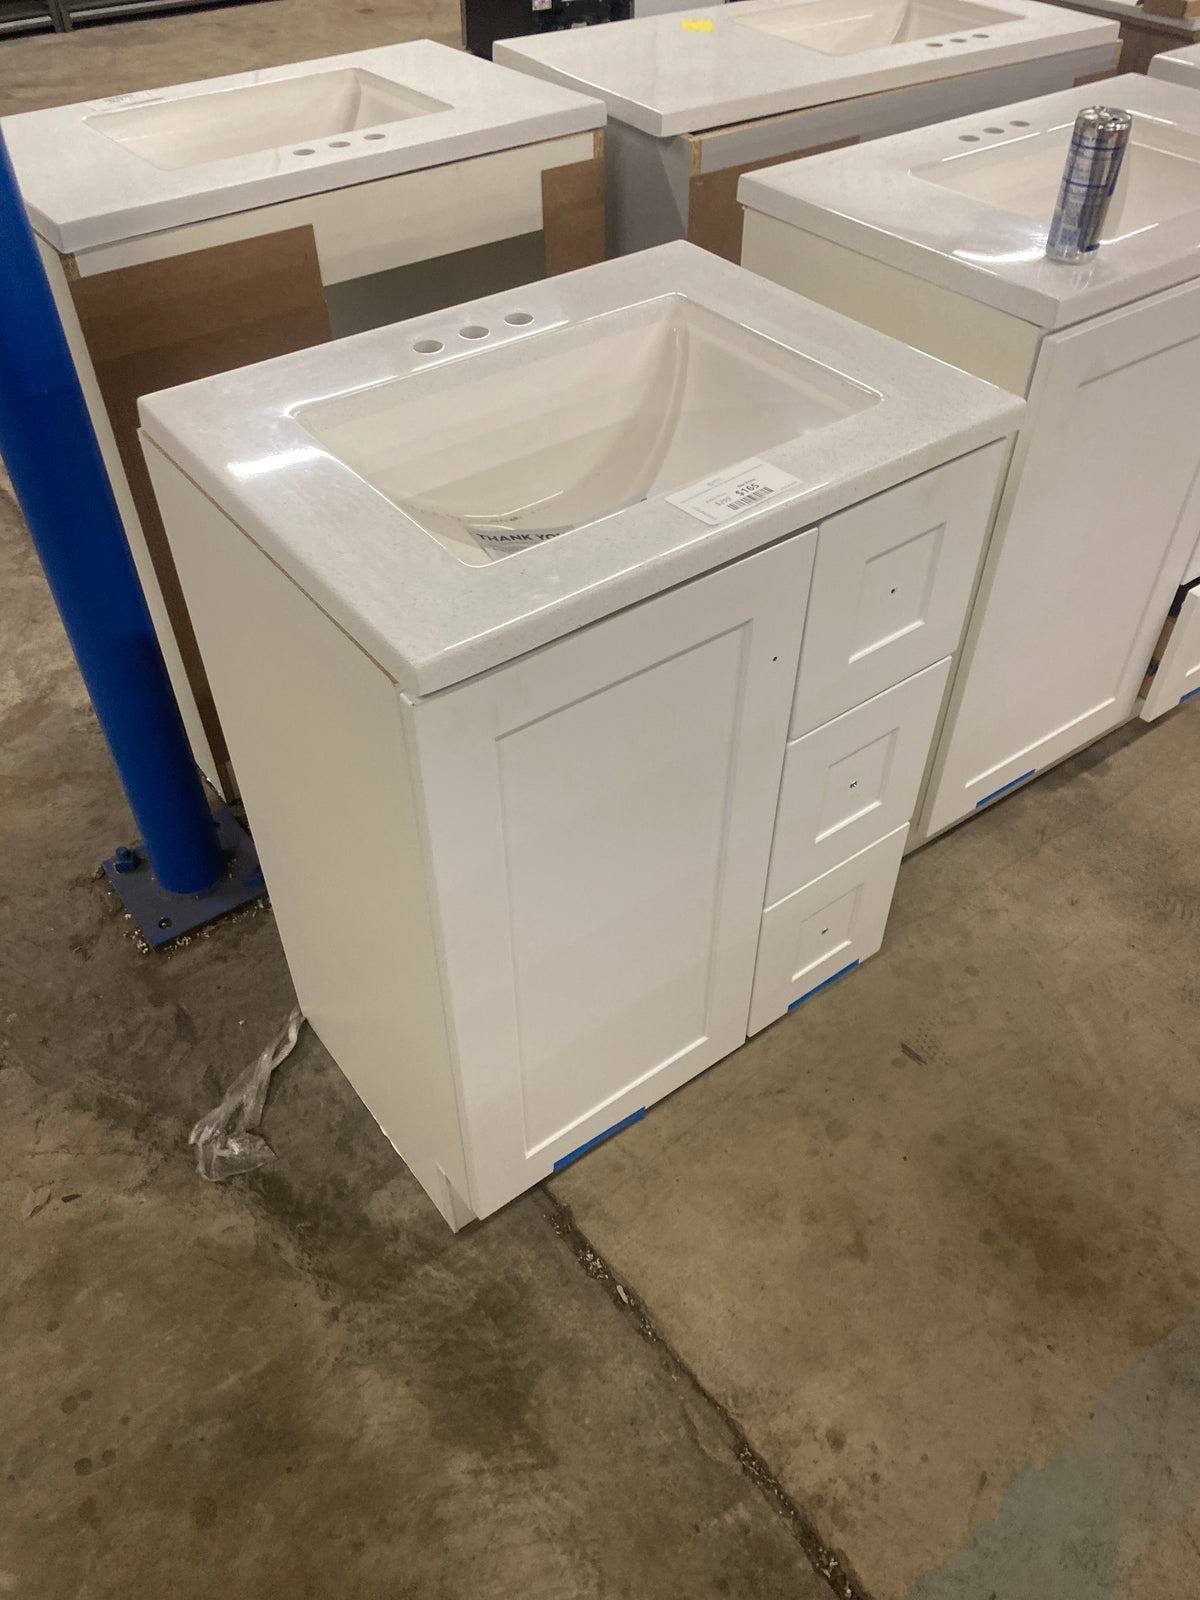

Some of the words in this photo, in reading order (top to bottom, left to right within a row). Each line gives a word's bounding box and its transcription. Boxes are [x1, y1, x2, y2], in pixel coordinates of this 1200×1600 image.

[735, 482, 760, 496] $165
[476, 533, 533, 543] THANK
[535, 532, 561, 541] YO
